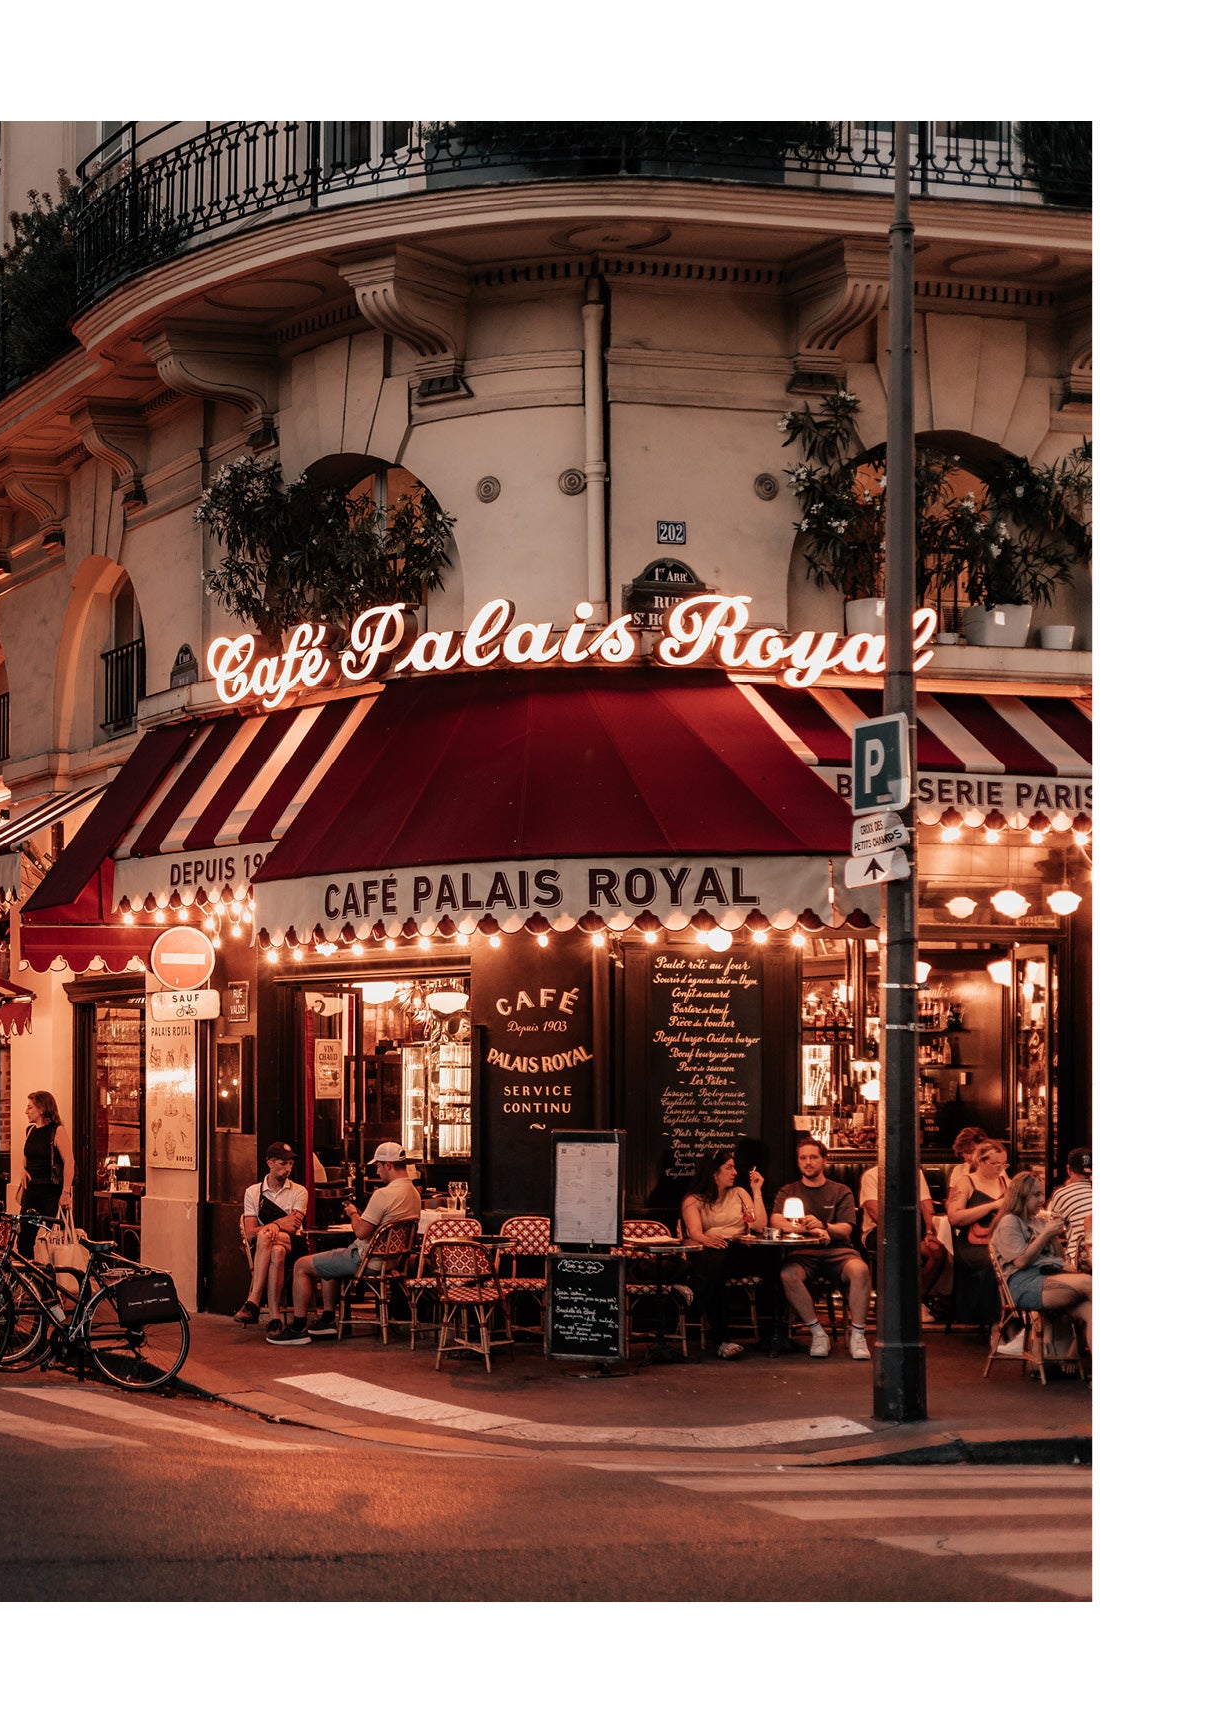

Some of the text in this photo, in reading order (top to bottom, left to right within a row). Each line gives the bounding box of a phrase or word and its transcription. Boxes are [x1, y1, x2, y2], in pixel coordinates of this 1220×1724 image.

[660, 524, 684, 541] 202
[207, 624, 330, 708] Café
[341, 599, 636, 680] Palais
[864, 738, 885, 794] P
[836, 774, 1003, 807] BSERIE
[860, 820, 884, 836] CROIX DES
[854, 828, 902, 851] PETITS CHAMPS
[170, 856, 235, 886] DEPUIS
[324, 867, 760, 919] CAFÉ PALAIS ROYAL
[654, 956, 686, 969] Poulet
[724, 957, 751, 976] four
[653, 973, 681, 984] Souris
[172, 993, 200, 1003] SAUF
[232, 988, 243, 999] RUE
[495, 987, 580, 1016] CAFÉ
[671, 987, 697, 1004] Confit
[703, 989, 731, 998] canard
[672, 1003, 702, 1014] Tartare
[506, 1020, 568, 1037] Depuis 1903
[703, 1016, 736, 1028] boucher
[151, 1025, 191, 1037] PALAIS ROYAL
[653, 1030, 682, 1047] Royal
[735, 1032, 761, 1048] burger
[319, 1053, 338, 1061] CHAUD
[486, 1045, 594, 1073] PALAIS ROYAL
[695, 1047, 746, 1063] bourguignon
[689, 1074, 703, 1086] Les
[503, 1085, 573, 1096] SERVICE
[662, 1086, 694, 1099] Lasagne
[503, 1102, 572, 1114] CONTINU
